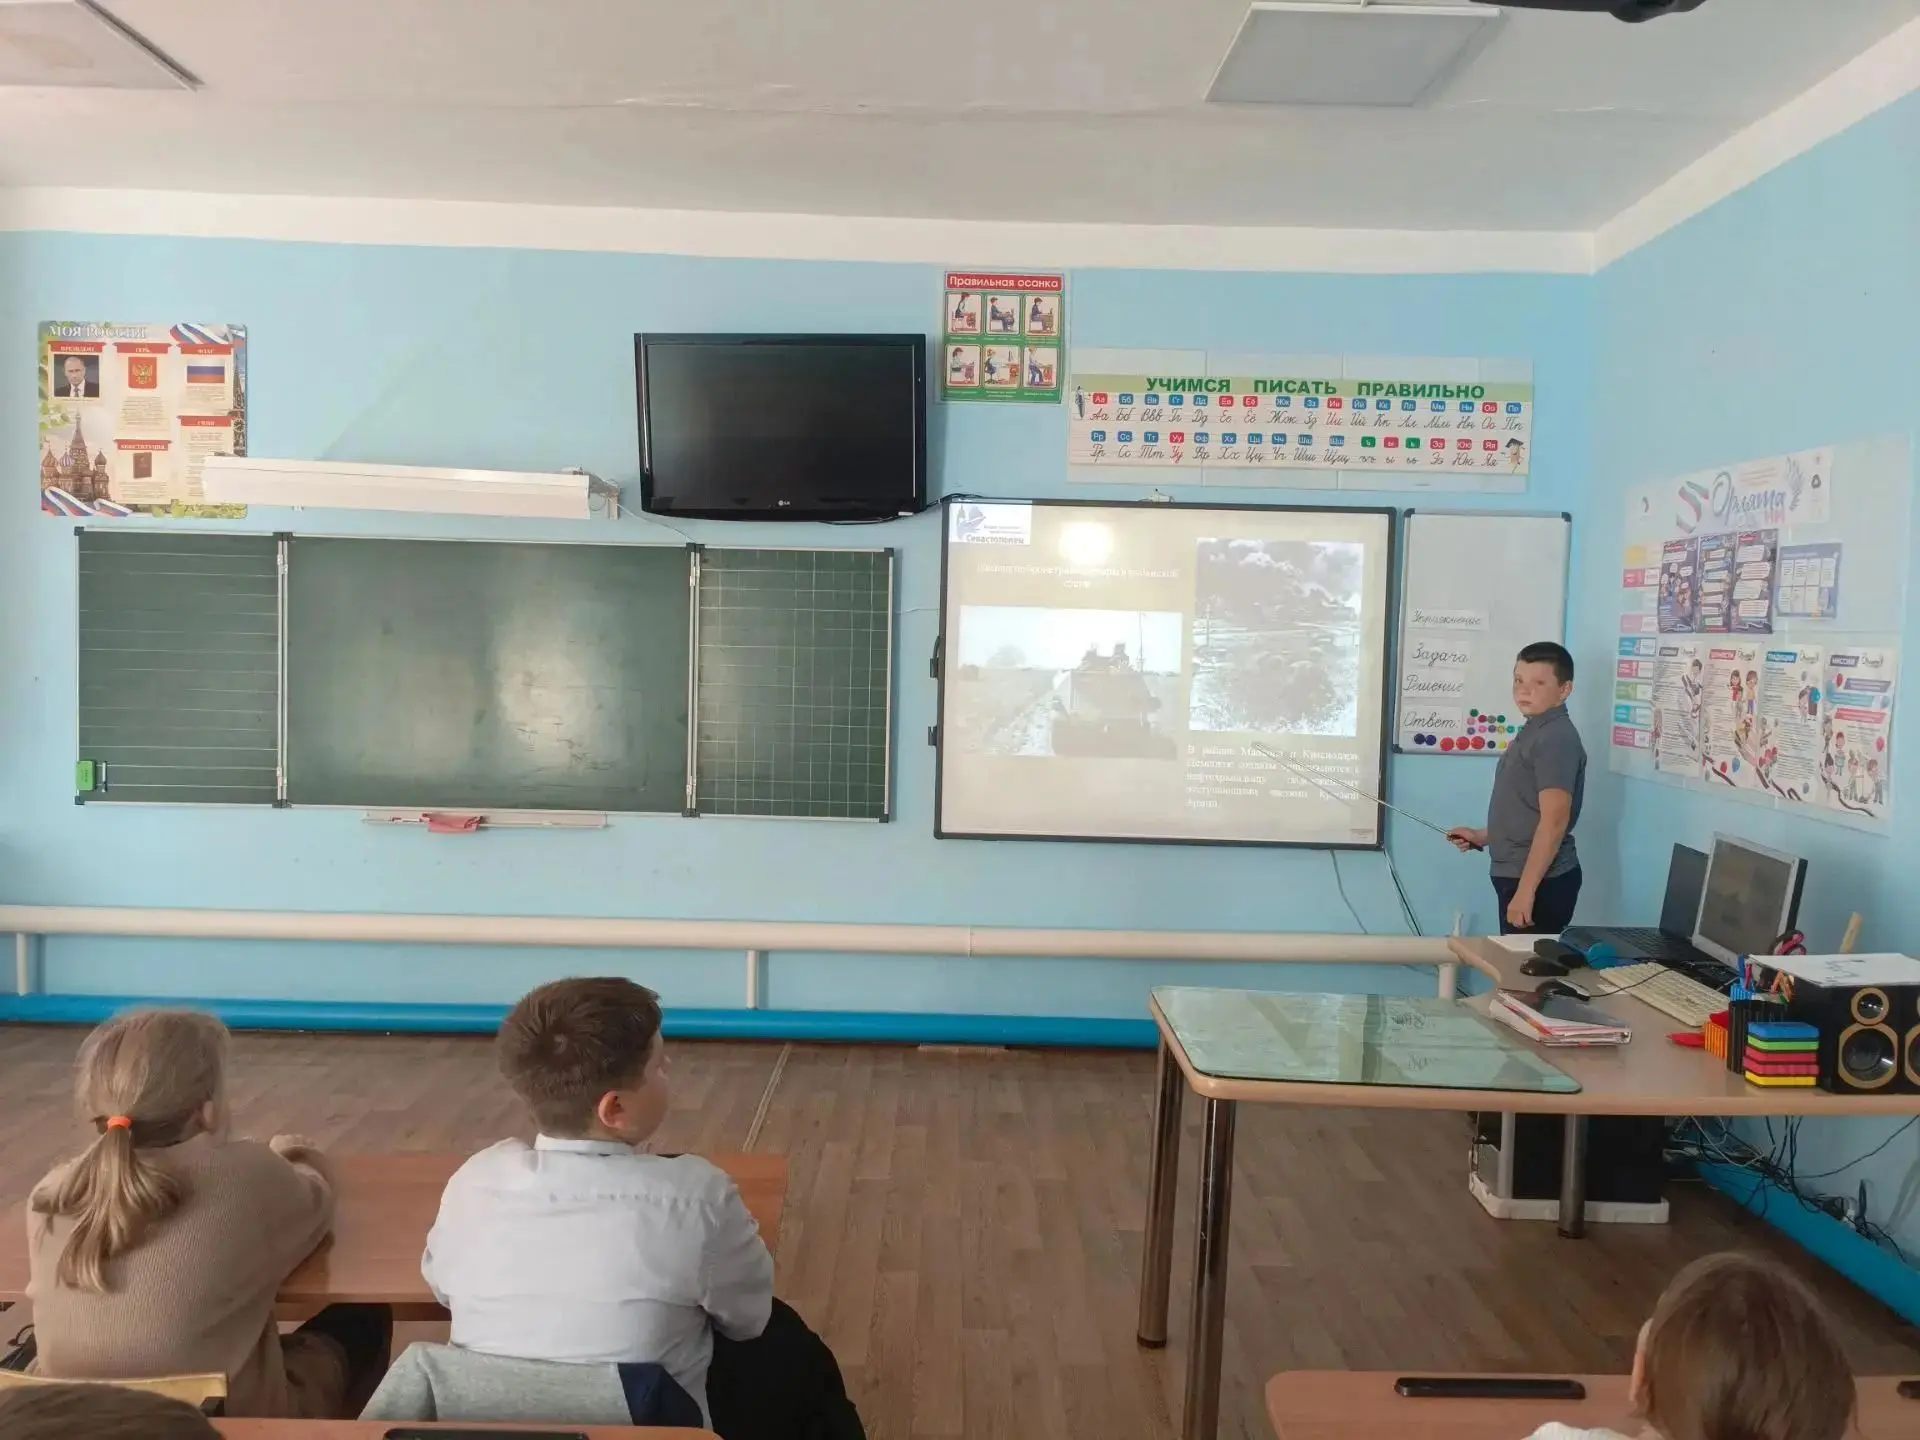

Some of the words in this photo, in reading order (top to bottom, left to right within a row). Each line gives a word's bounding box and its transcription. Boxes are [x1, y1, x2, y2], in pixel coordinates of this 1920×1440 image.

[949, 276, 1015, 287] Правильная
[1018, 279, 1058, 288] осанка
[48, 325, 81, 337] МОЯ
[1146, 378, 1230, 393] УЧИМСЯ
[1254, 380, 1336, 394] ПИСАТЬ
[1357, 382, 1484, 398] ПРАВИЛЬНО
[1094, 395, 1106, 403] Аа
[1089, 407, 1110, 421] Аа
[1712, 471, 1788, 526] Орлята
[1412, 643, 1468, 666] Задача
[1403, 674, 1464, 691] Решение
